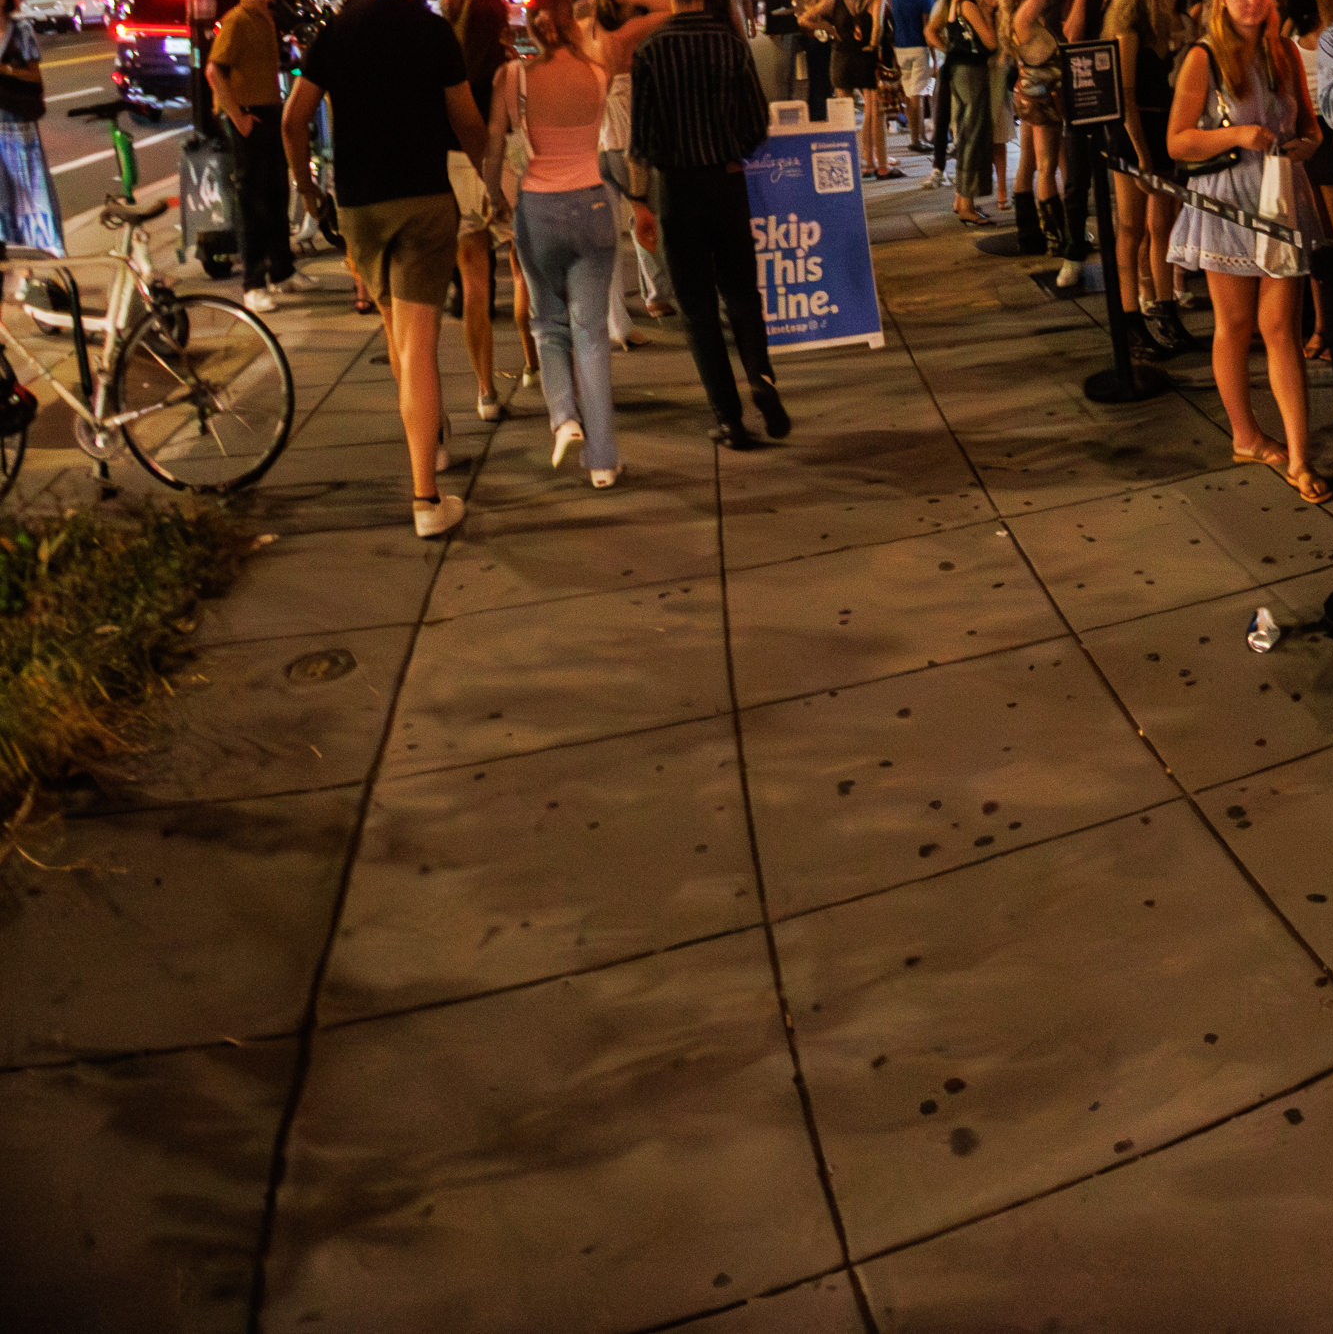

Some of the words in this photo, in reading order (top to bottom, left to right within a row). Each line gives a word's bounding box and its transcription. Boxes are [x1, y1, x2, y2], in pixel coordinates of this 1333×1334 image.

[750, 213, 822, 255] Skip
[755, 248, 823, 288] This
[759, 286, 839, 322] Line.
